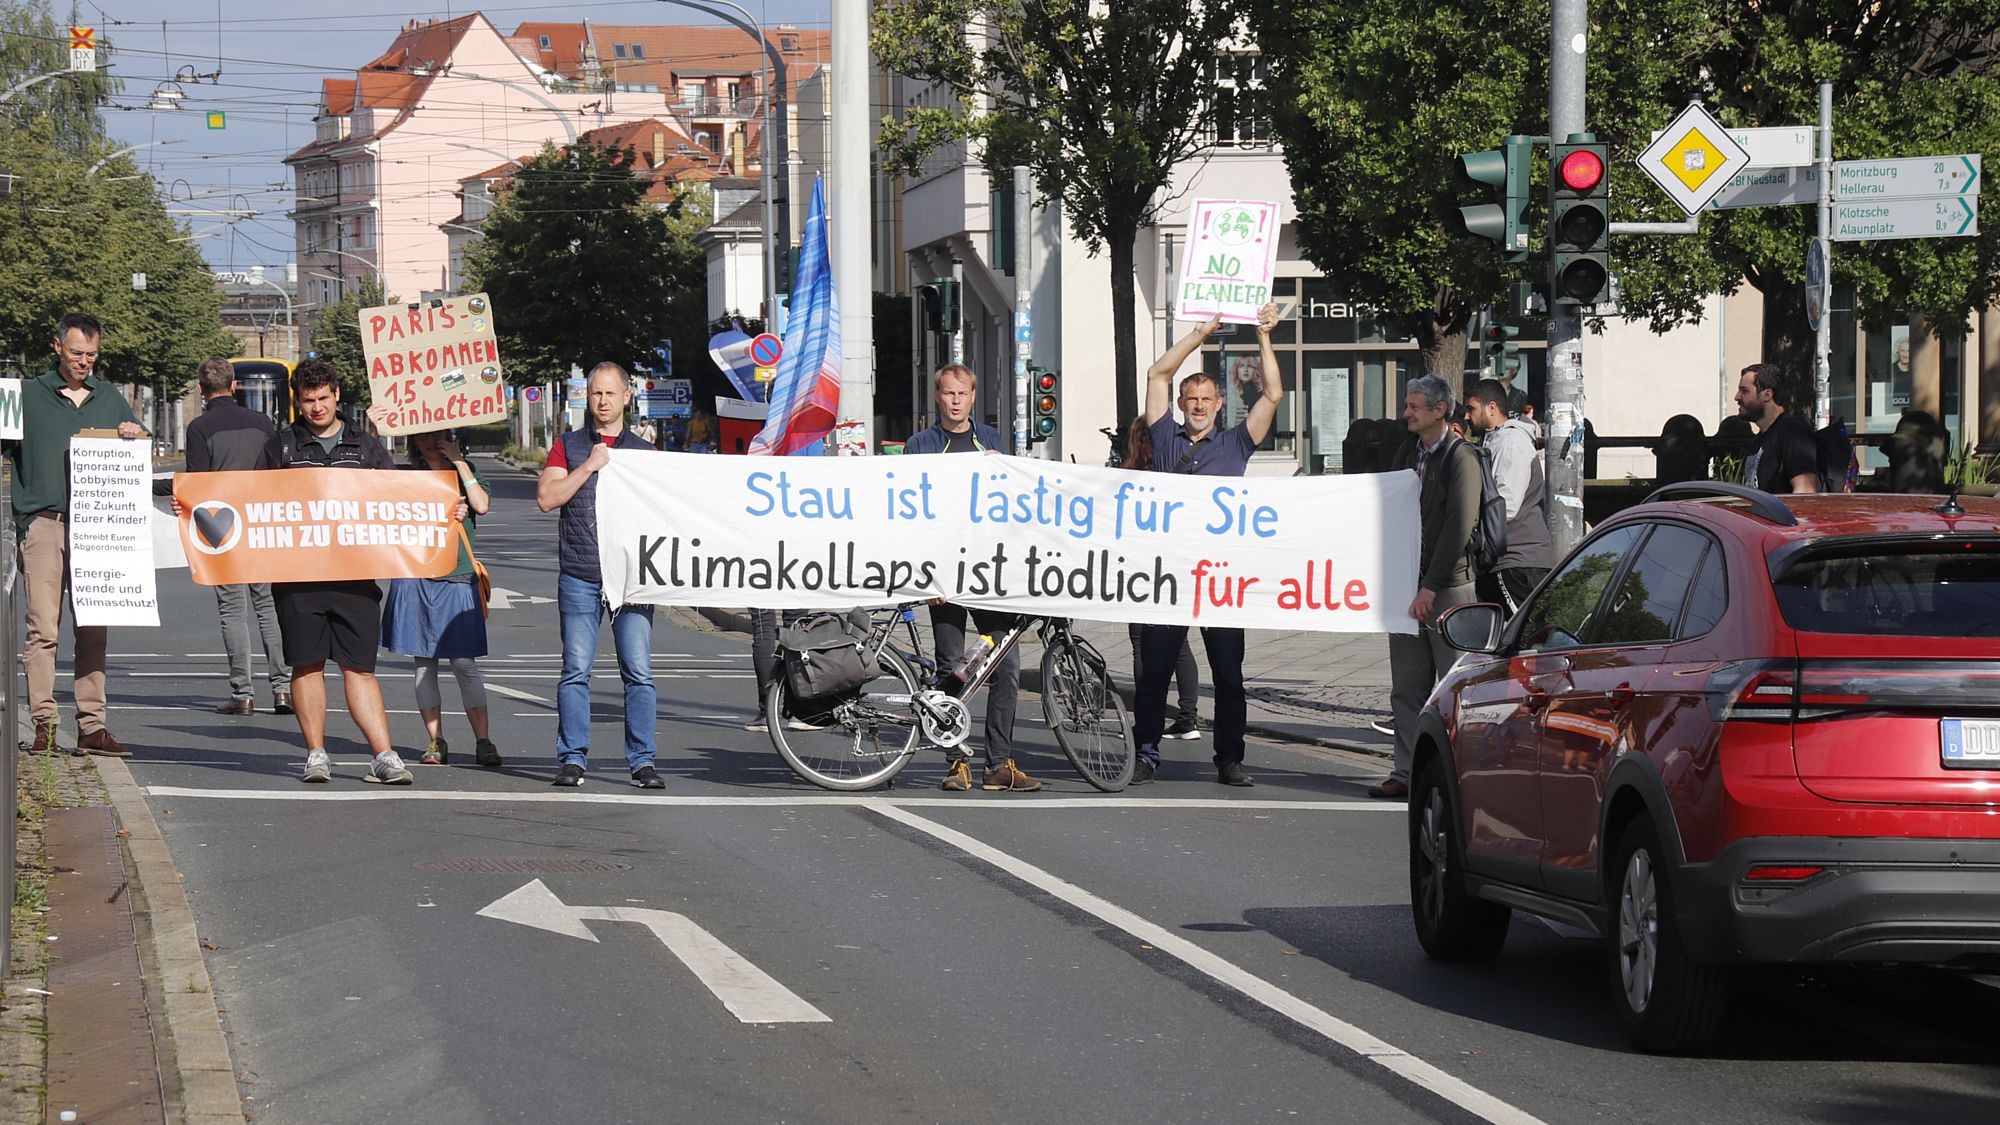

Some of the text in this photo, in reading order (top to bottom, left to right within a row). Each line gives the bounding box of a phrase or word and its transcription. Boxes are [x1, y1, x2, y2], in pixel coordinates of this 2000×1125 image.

[1840, 162, 1944, 178] Moritzburg 20
[1747, 173, 1786, 186] Neustadt
[1840, 184, 1884, 194] Hellerau
[1840, 207, 1889, 219] Klotzsche
[1840, 224, 1894, 236] Alaunplatz
[1204, 254, 1240, 276] NO
[370, 304, 468, 344] PARIS-
[372, 340, 496, 379] ABKOMMEN
[386, 384, 503, 428] einhalten!
[73, 448, 134, 460] Korruption,
[74, 462, 144, 472] Ignoranz und
[74, 475, 140, 486] Lobbyismus
[73, 488, 124, 498] zerstören
[74, 500, 136, 512] die Zukunft
[745, 471, 1278, 540] Stau ist lästig für Sie
[245, 500, 448, 524] WEG VON FOSSIL
[74, 514, 146, 524] Eurer Kinder!
[74, 532, 136, 542] Schreibt Euren
[248, 524, 448, 549] HIN ZU GERECHT
[75, 568, 126, 581] Energie-
[638, 534, 1371, 619] Klimakollaps ist tödlich für alle
[75, 584, 142, 594] wende und
[76, 598, 156, 608] Klimaschutz!
[1950, 744, 1958, 752] D
